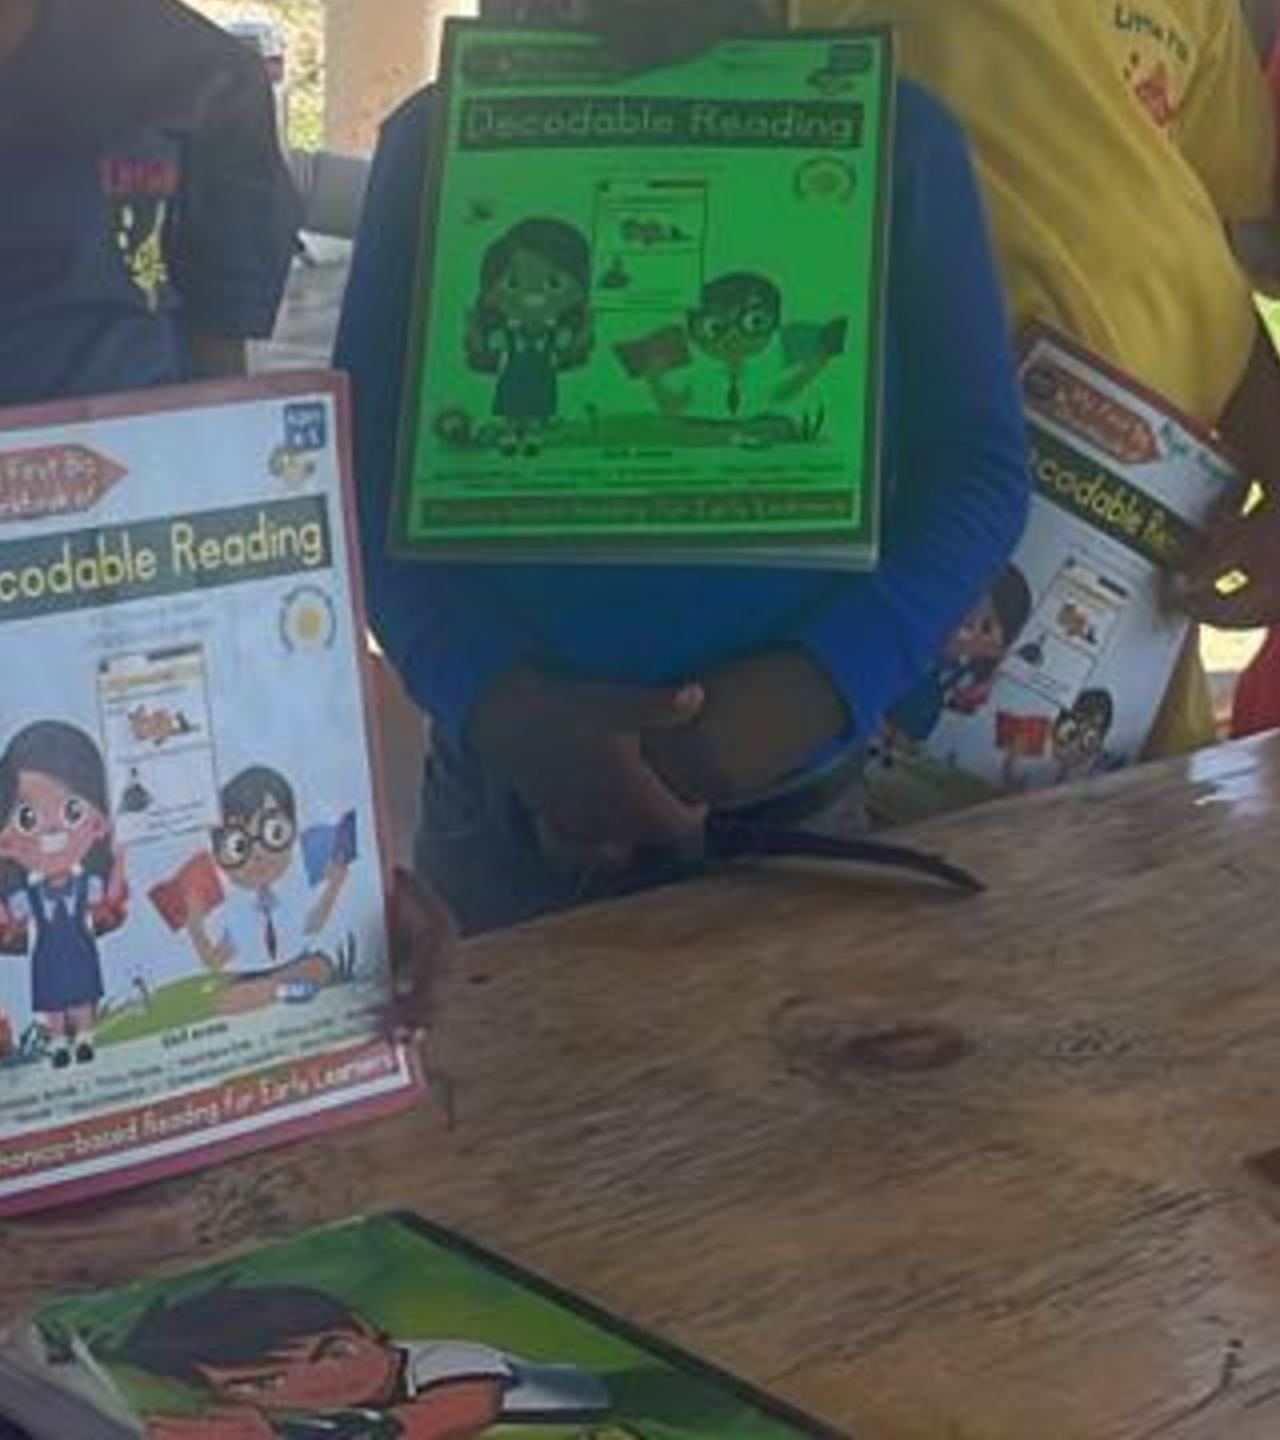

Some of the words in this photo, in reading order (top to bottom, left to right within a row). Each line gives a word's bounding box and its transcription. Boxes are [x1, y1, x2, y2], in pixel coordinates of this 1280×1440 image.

[467, 104, 674, 141] Decodable
[689, 106, 854, 143] Reading
[170, 512, 322, 576] Reading
